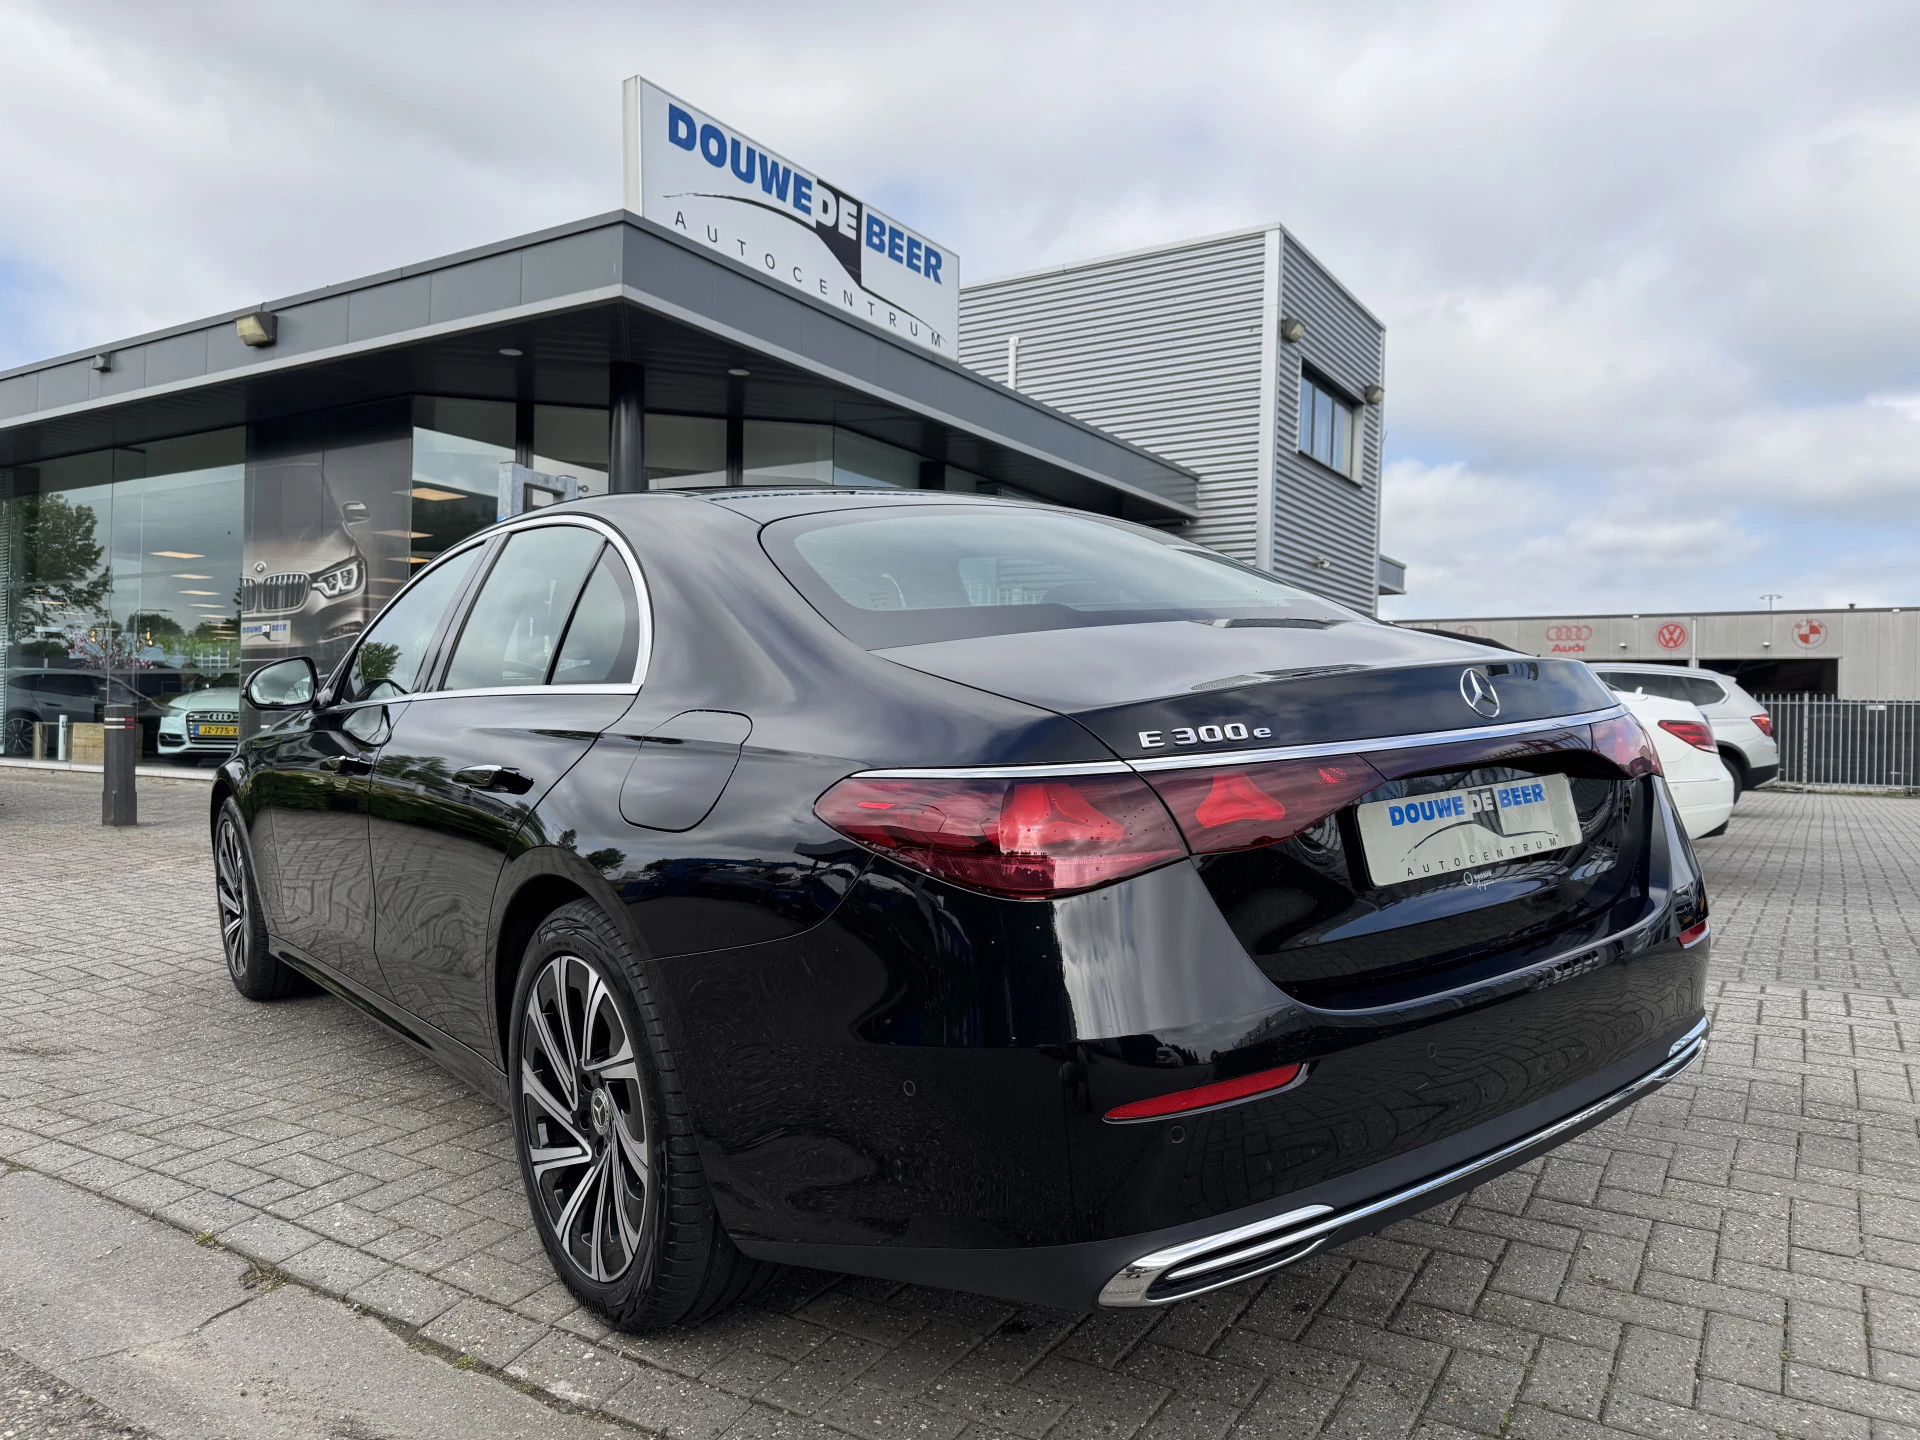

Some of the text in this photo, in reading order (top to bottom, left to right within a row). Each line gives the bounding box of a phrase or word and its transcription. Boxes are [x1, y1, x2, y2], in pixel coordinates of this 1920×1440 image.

[668, 102, 943, 285] DOUWE DE BEER
[675, 211, 941, 348] AUTOCENTRUM
[1551, 643, 1585, 653] Audi
[1138, 731, 1165, 748] E
[1388, 783, 1546, 827] DOUWE DE BEER
[1407, 837, 1558, 877] AUTOCENTRUM
